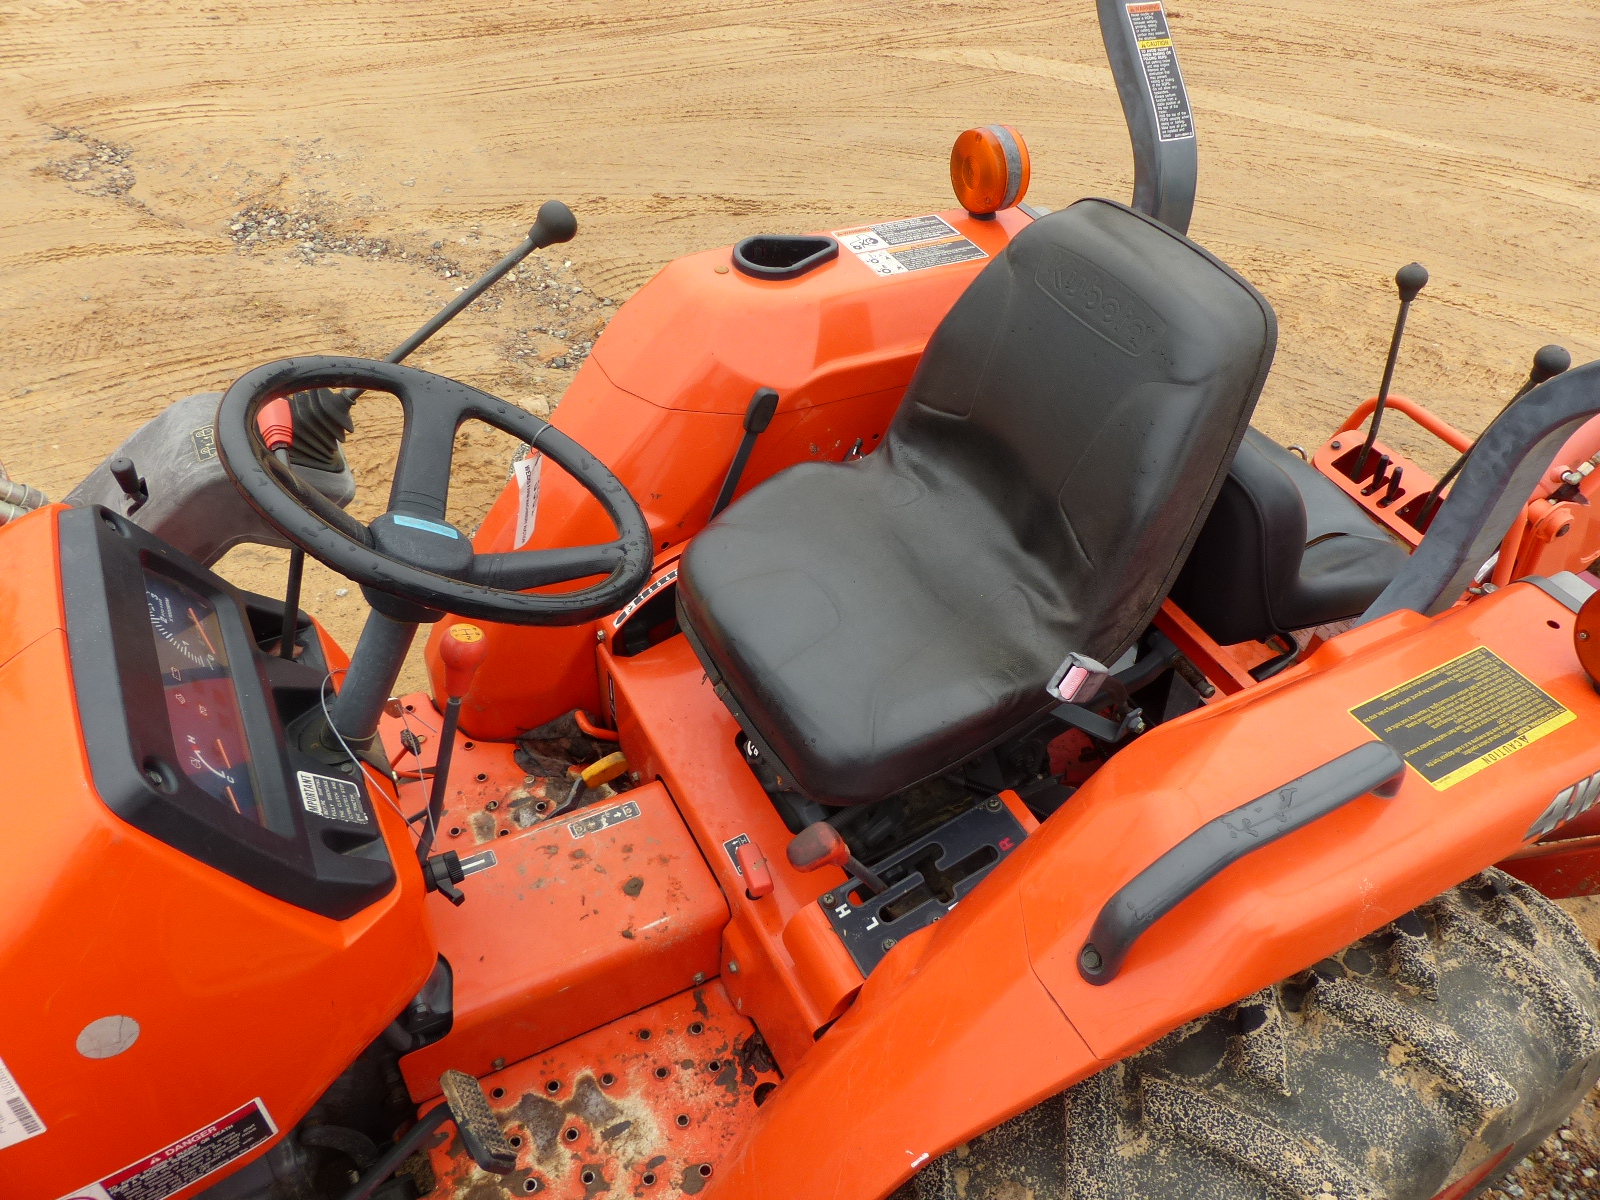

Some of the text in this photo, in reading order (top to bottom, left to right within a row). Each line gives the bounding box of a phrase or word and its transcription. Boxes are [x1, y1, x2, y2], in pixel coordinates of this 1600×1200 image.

[187, 734, 196, 744] H
[1480, 738, 1524, 764] CAUTION
[998, 837, 1014, 851] R
[835, 903, 852, 918] H
[866, 916, 879, 931] L
[164, 1125, 217, 1156] DANGER
